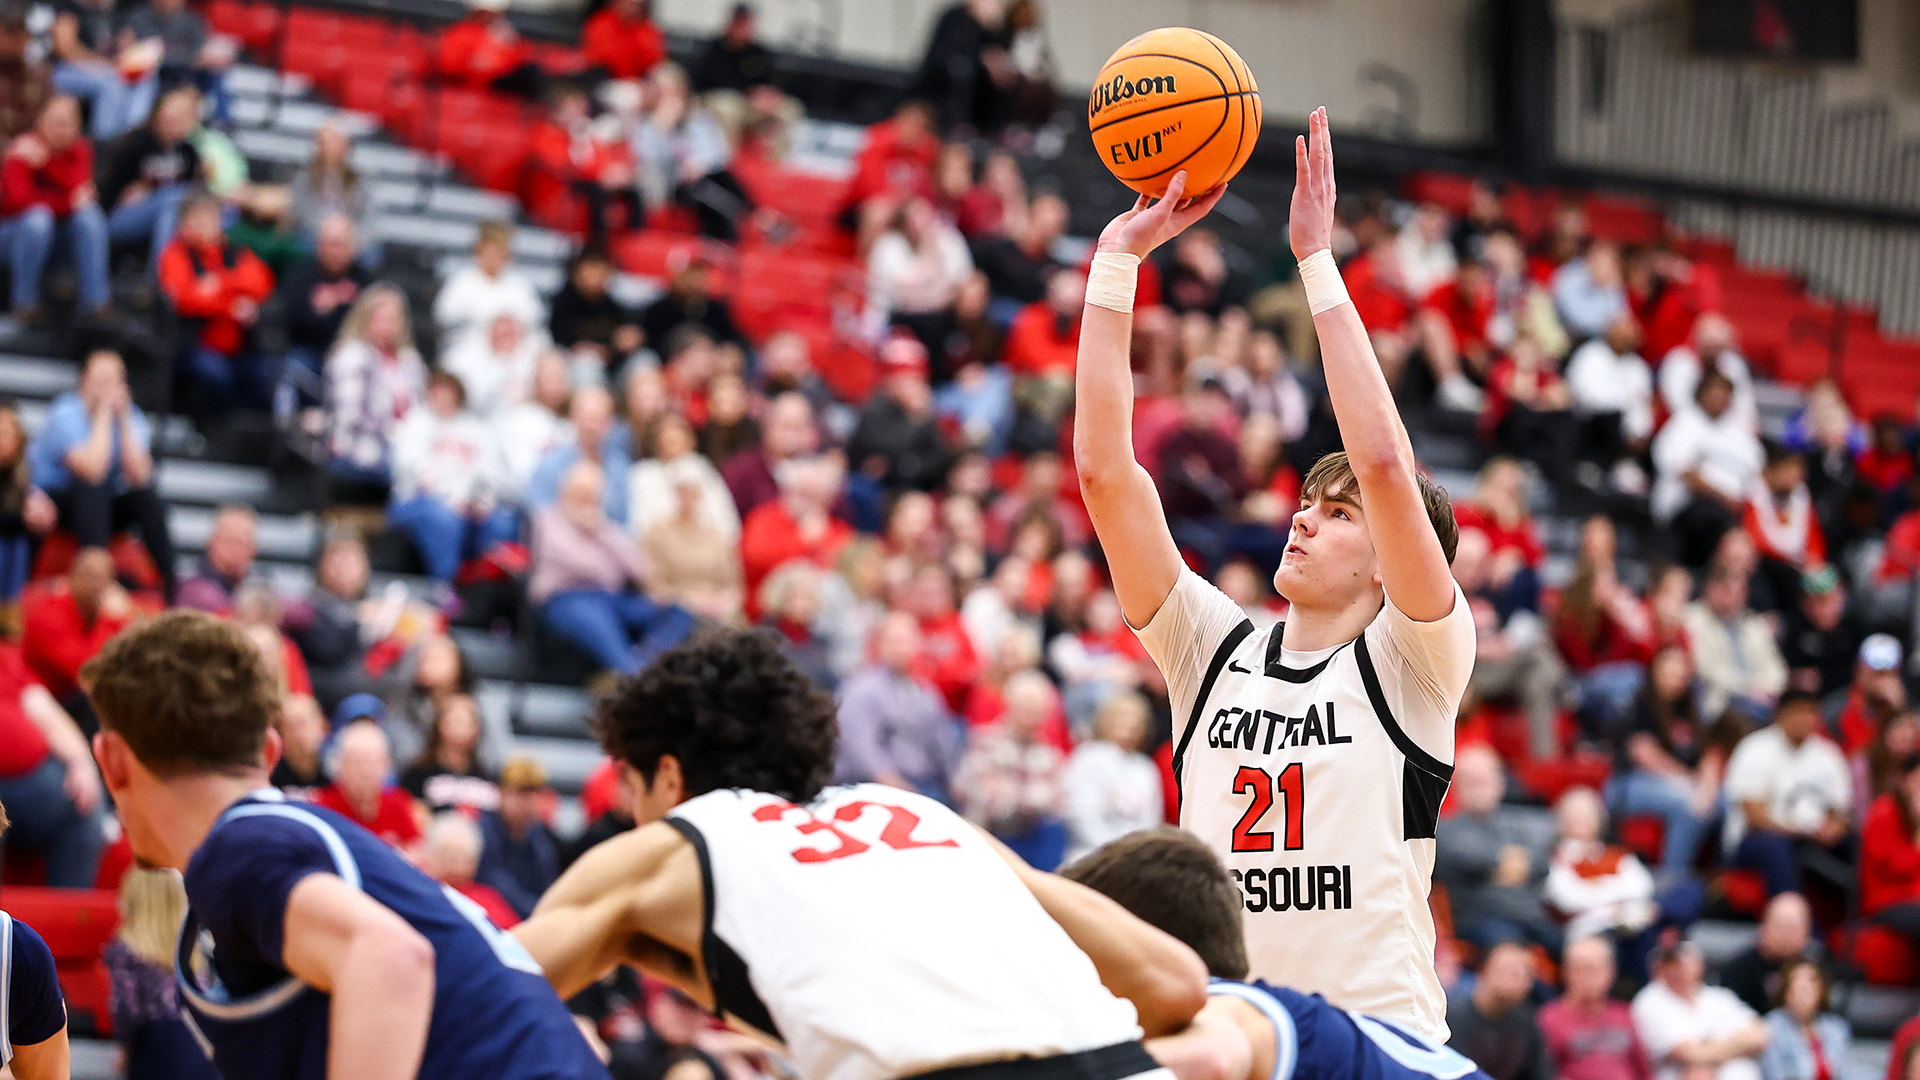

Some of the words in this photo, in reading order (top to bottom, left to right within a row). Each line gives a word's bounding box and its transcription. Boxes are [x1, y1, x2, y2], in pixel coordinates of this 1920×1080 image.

[1090, 74, 1177, 118] Wilson
[1207, 702, 1353, 755] CENTRAL
[751, 801, 961, 864] 32
[1231, 762, 1304, 853] 21
[1228, 865, 1352, 913] SOURI
